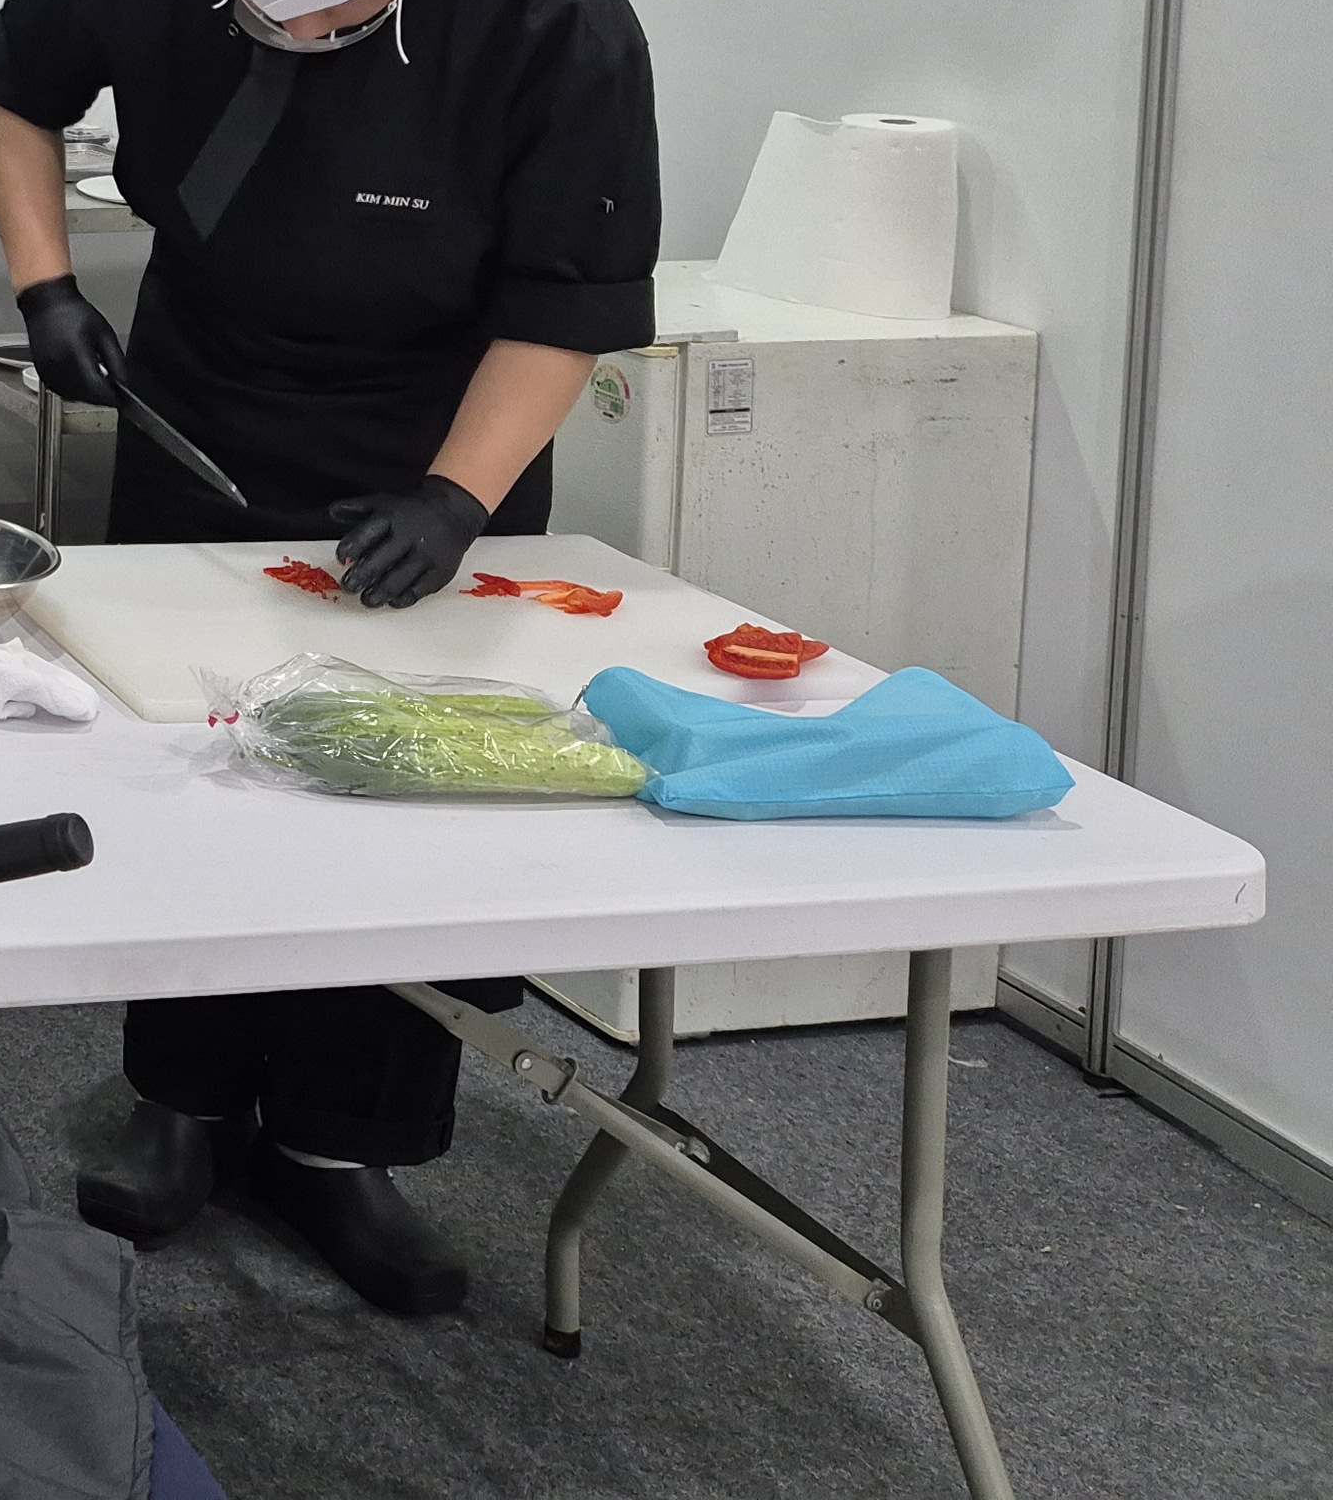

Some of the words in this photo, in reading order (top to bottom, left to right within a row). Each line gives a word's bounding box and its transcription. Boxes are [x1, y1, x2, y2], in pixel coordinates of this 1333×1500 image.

[355, 192, 381, 205] KIM
[383, 195, 411, 207] MIN
[412, 198, 430, 210] SU
